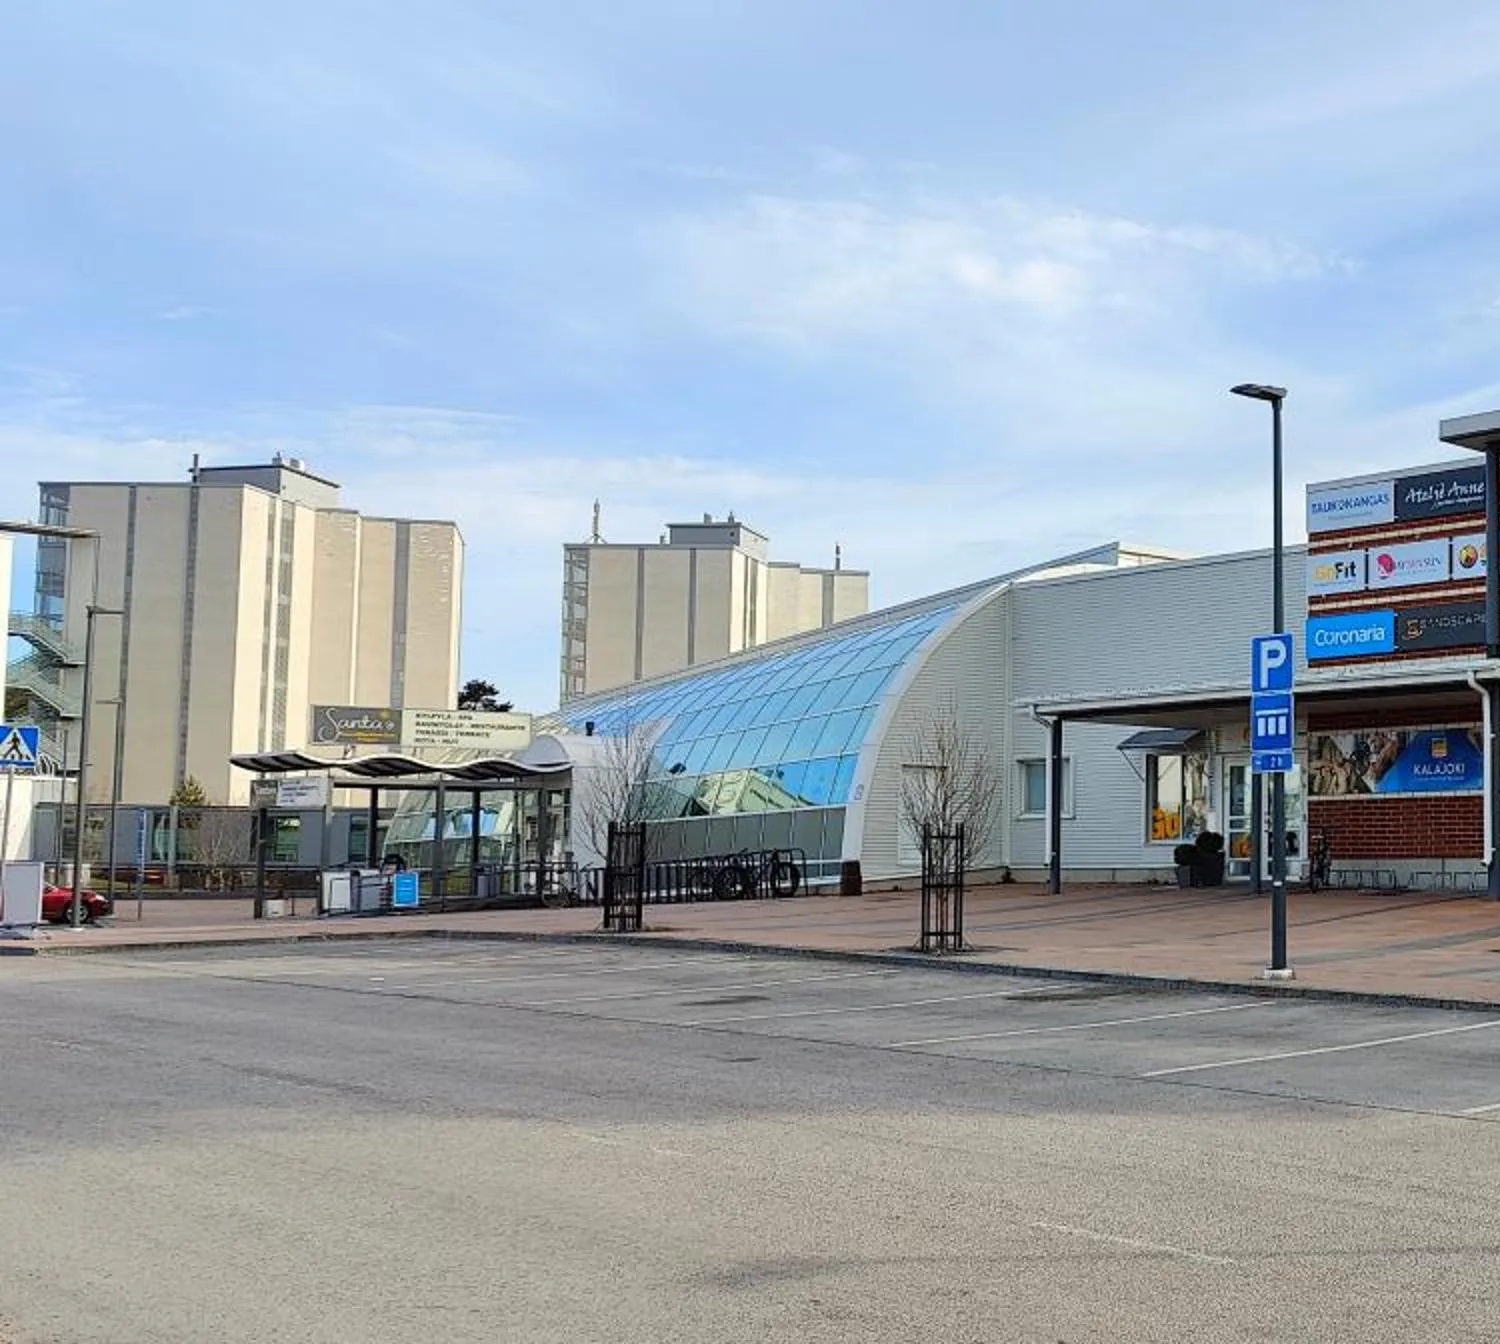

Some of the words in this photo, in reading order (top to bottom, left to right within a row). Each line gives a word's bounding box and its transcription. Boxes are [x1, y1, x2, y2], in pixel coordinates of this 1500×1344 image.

[1315, 624, 1386, 647] Coronaria
[1259, 639, 1287, 689] P
[1413, 763, 1465, 776] KALAJOKI
